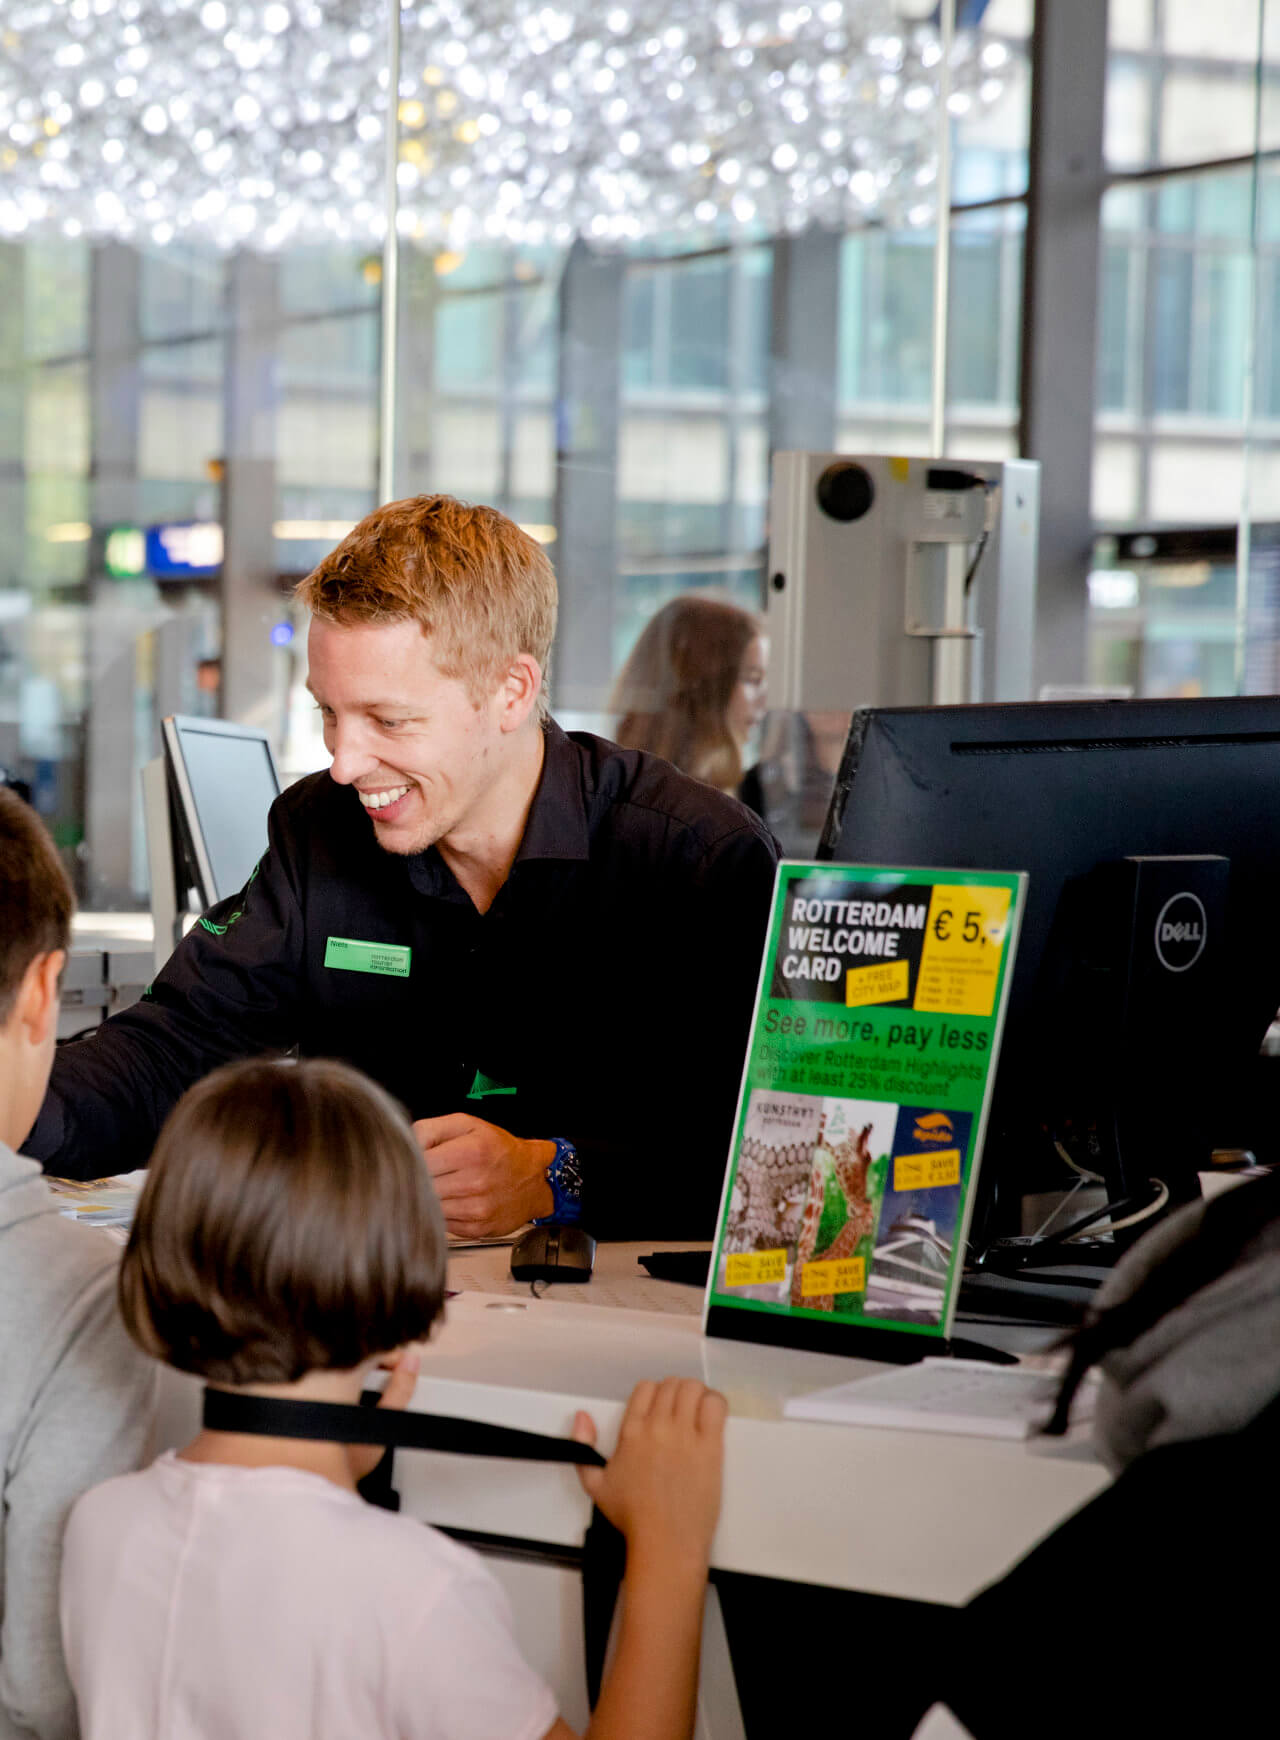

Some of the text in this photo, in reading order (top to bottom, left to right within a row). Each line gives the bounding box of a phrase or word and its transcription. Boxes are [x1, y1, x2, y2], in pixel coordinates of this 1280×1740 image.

[791, 898, 926, 929] ROTTERDAM
[933, 909, 953, 941] €
[788, 927, 900, 957] WELCOME
[1161, 921, 1200, 942] DELL
[782, 955, 841, 981] CARD
[764, 1008, 989, 1051] See more, pay less
[760, 1044, 984, 1082] Discover Rotterdam Highlights
[757, 1064, 950, 1097] with at least 25% discount
